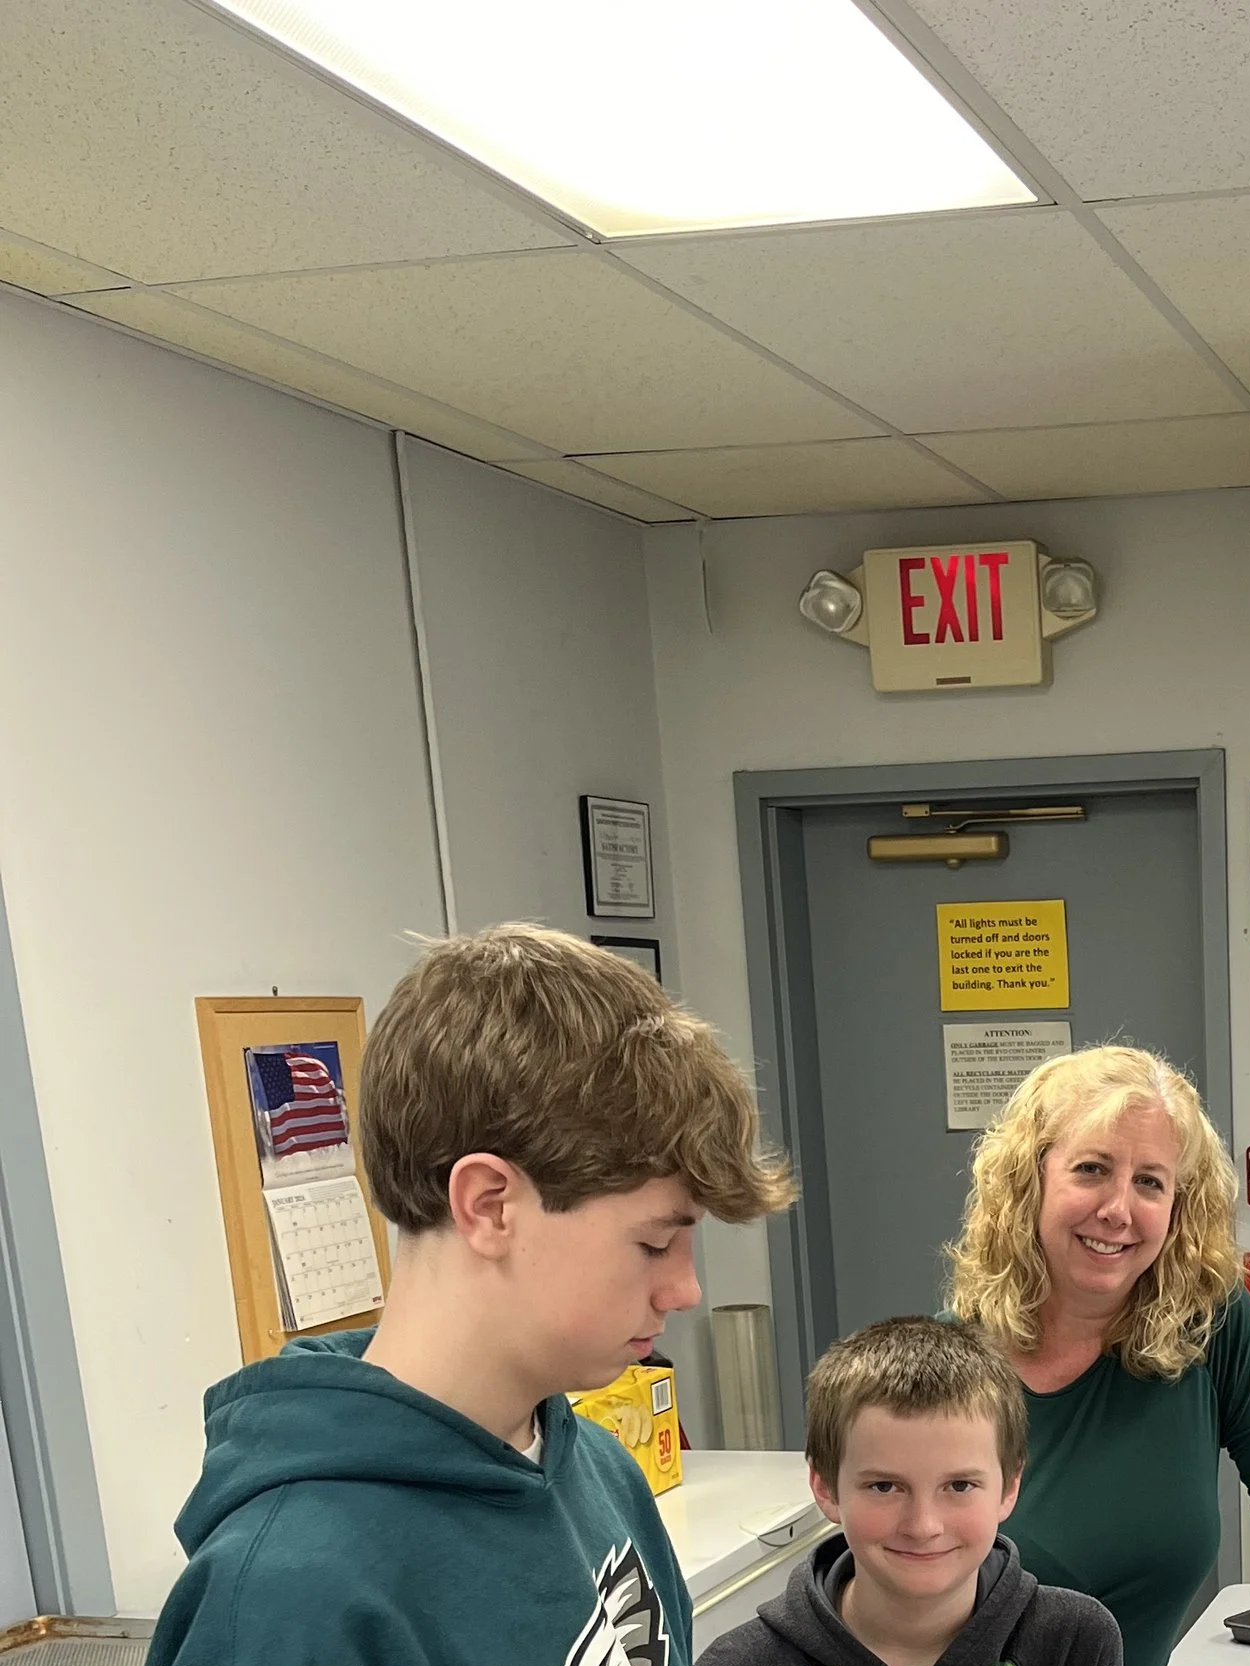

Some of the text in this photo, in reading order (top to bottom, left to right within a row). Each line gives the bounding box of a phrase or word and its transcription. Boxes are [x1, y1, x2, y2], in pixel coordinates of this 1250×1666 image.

[899, 552, 1008, 645] EXIT
[970, 919, 996, 930] lights
[998, 917, 1023, 928] must
[1025, 917, 1038, 926] be
[950, 932, 1050, 944] turned off and doors
[951, 948, 1049, 960] locked if you are the
[952, 963, 1042, 974] last one to exit the
[952, 980, 994, 991] building.
[997, 979, 1027, 989] Thank
[984, 1030, 1033, 1038] ATTENTION:
[659, 1429, 671, 1457] 50
